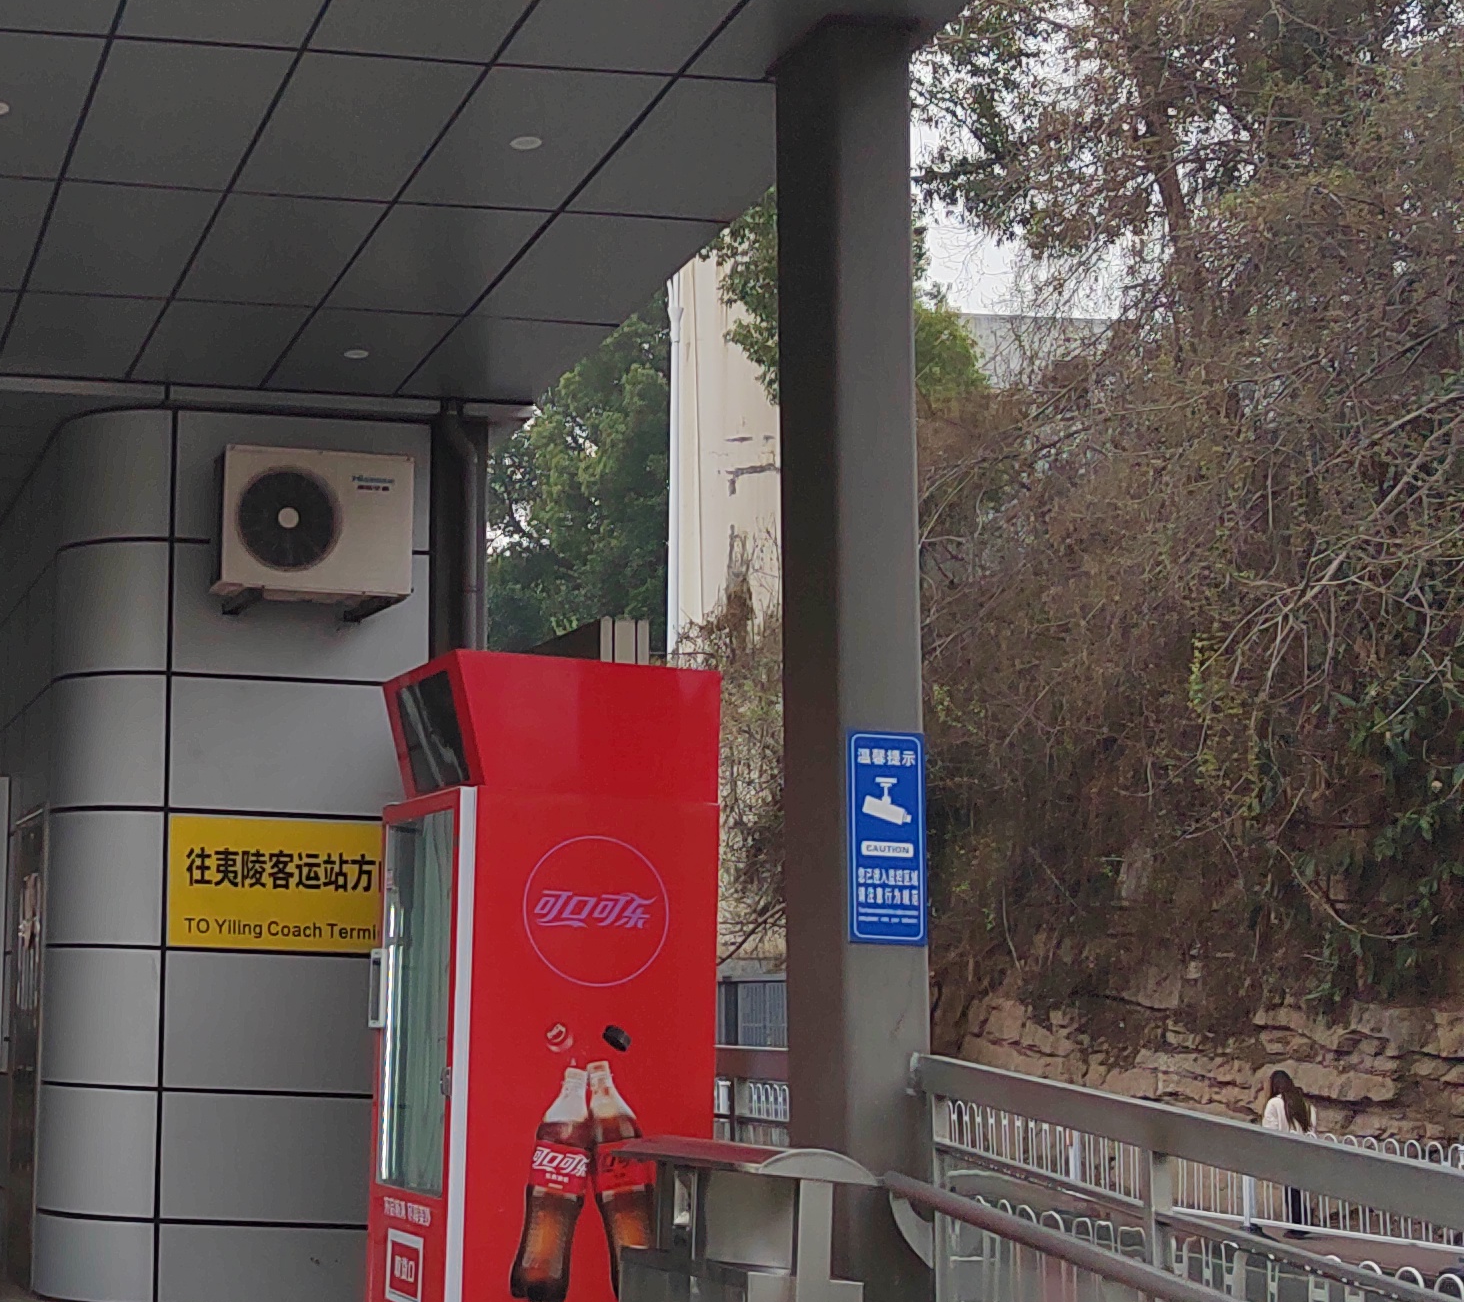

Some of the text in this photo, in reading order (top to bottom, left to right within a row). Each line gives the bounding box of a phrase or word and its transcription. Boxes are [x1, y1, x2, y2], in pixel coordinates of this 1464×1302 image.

[857, 748, 916, 767] 温馨提示
[866, 844, 910, 854] CAUTION
[186, 847, 382, 893] 往夷陵客运站方
[534, 889, 657, 929] 可口可乐
[184, 917, 380, 941] TO Yiling Coach Termi
